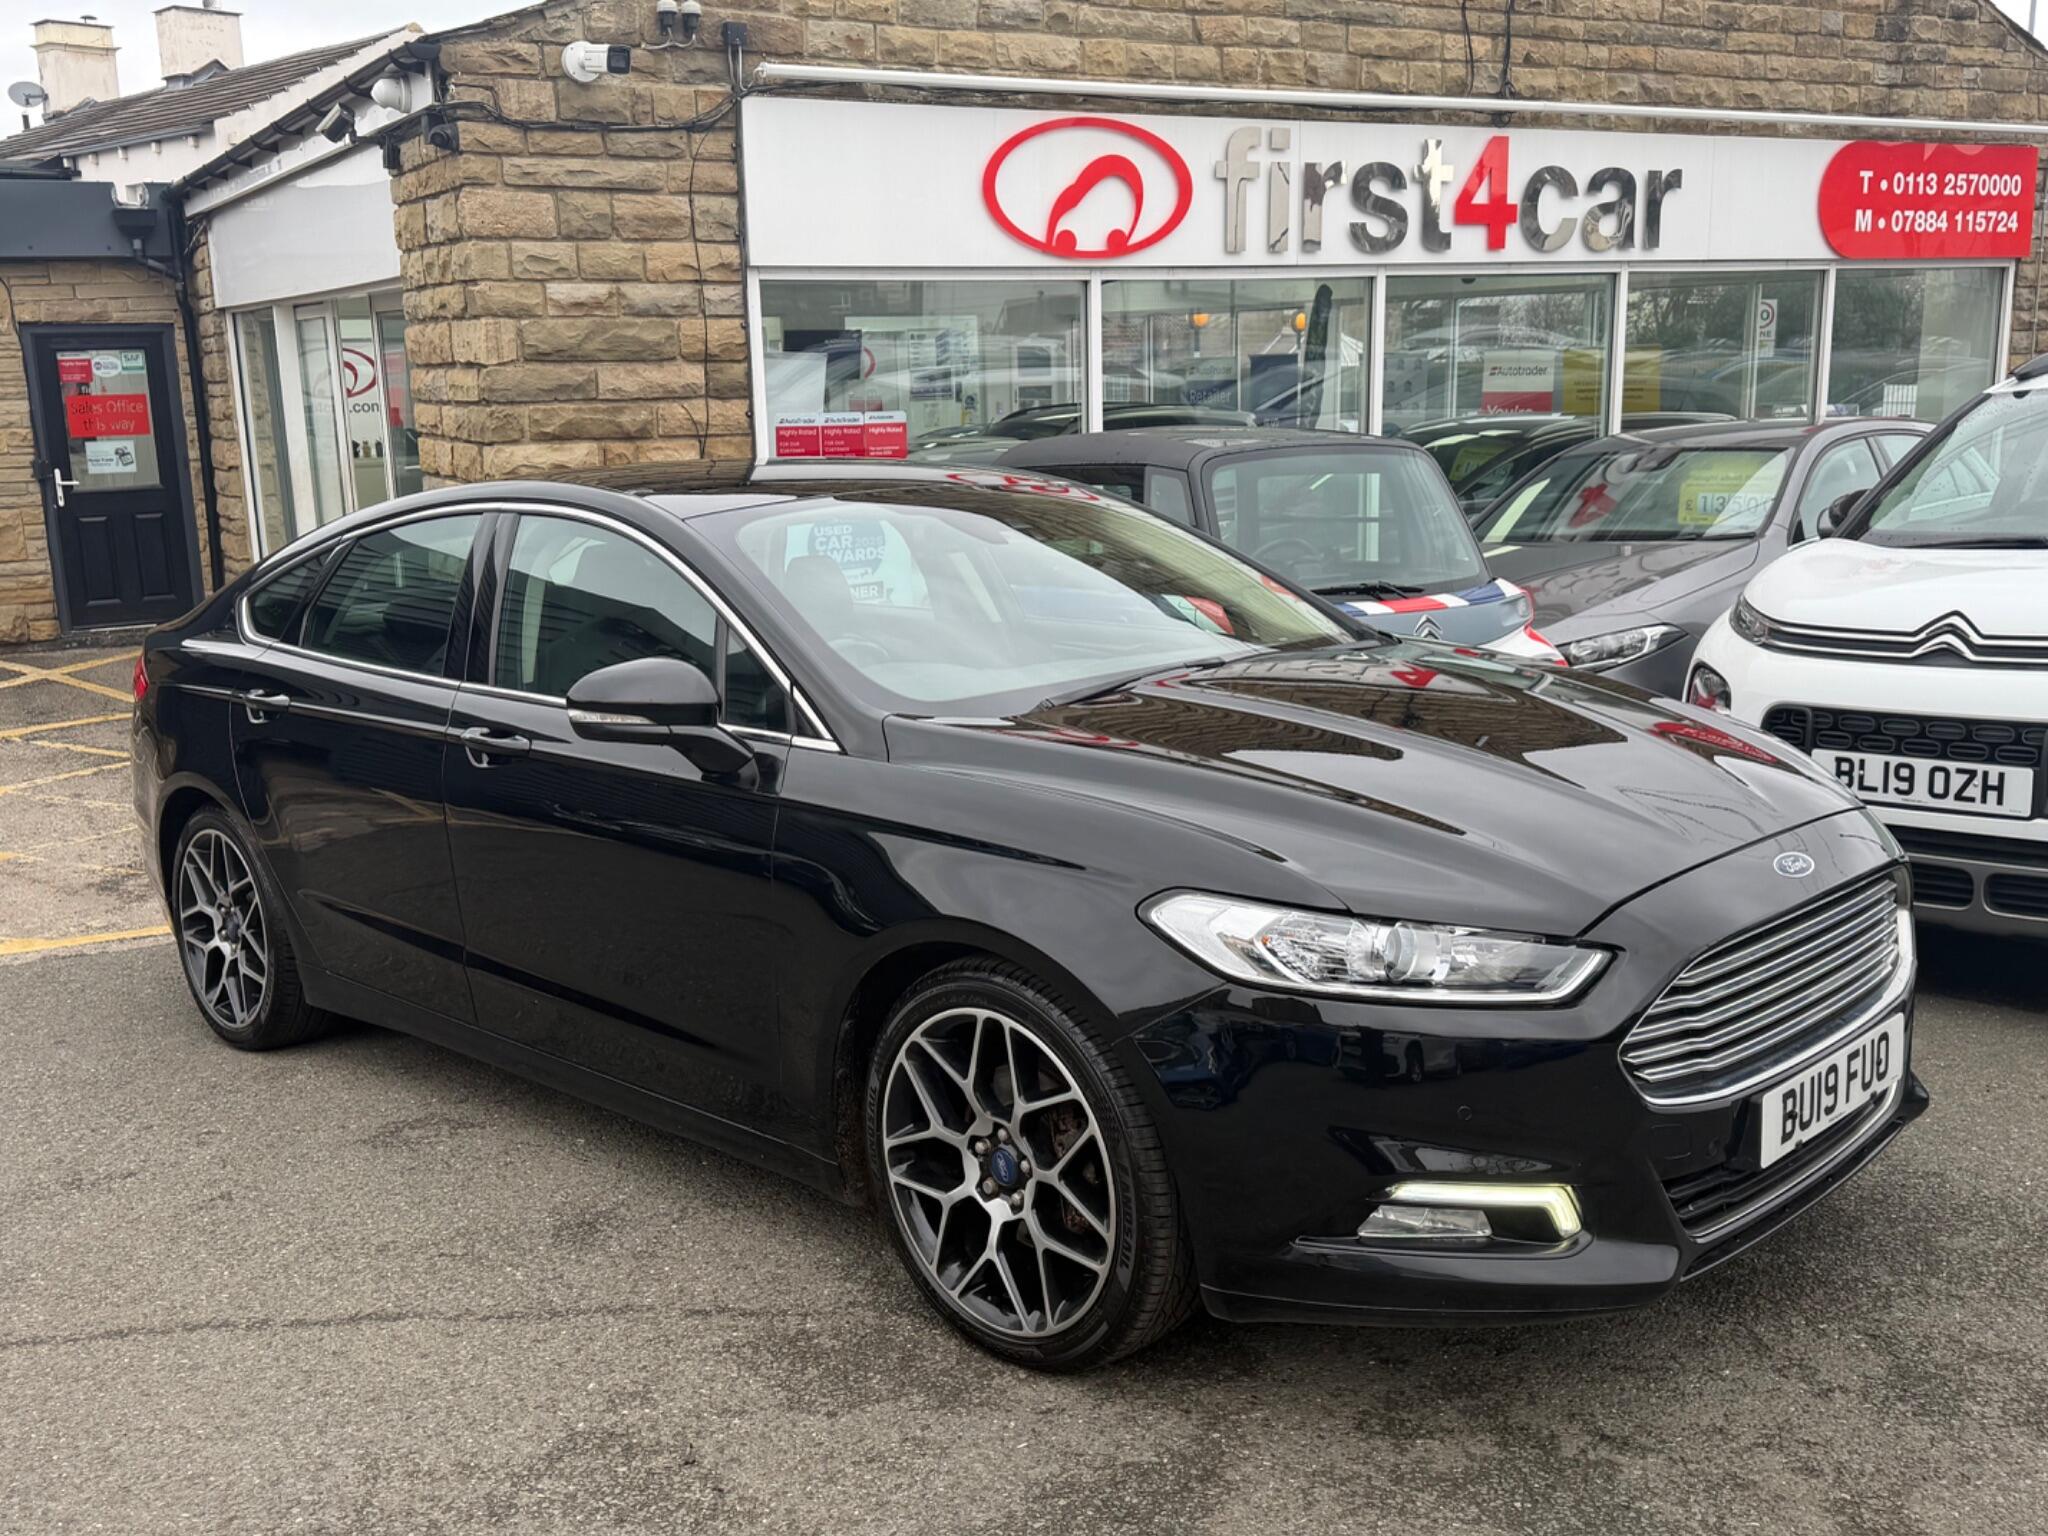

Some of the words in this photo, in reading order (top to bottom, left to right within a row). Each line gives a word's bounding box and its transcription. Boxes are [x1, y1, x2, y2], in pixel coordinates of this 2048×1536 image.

[1215, 126, 1682, 253] first4car
[1860, 170, 1874, 194] T
[1893, 172, 1938, 195] 0113
[1943, 173, 2022, 197] 2570000
[1855, 209, 1873, 233] M
[1891, 210, 1949, 233] 07884
[1955, 211, 2019, 233] 115724
[1498, 364, 1547, 377] Autotrader
[72, 400, 102, 415] Sales
[105, 399, 144, 413] Office
[83, 417, 106, 431] this
[112, 418, 135, 432] way
[814, 525, 853, 537] USED
[815, 534, 854, 551] CAR
[816, 546, 885, 563] WARDS
[1834, 756, 1915, 797] BL19
[1928, 765, 2006, 806] OZH
[1780, 1062, 1839, 1146] BU19
